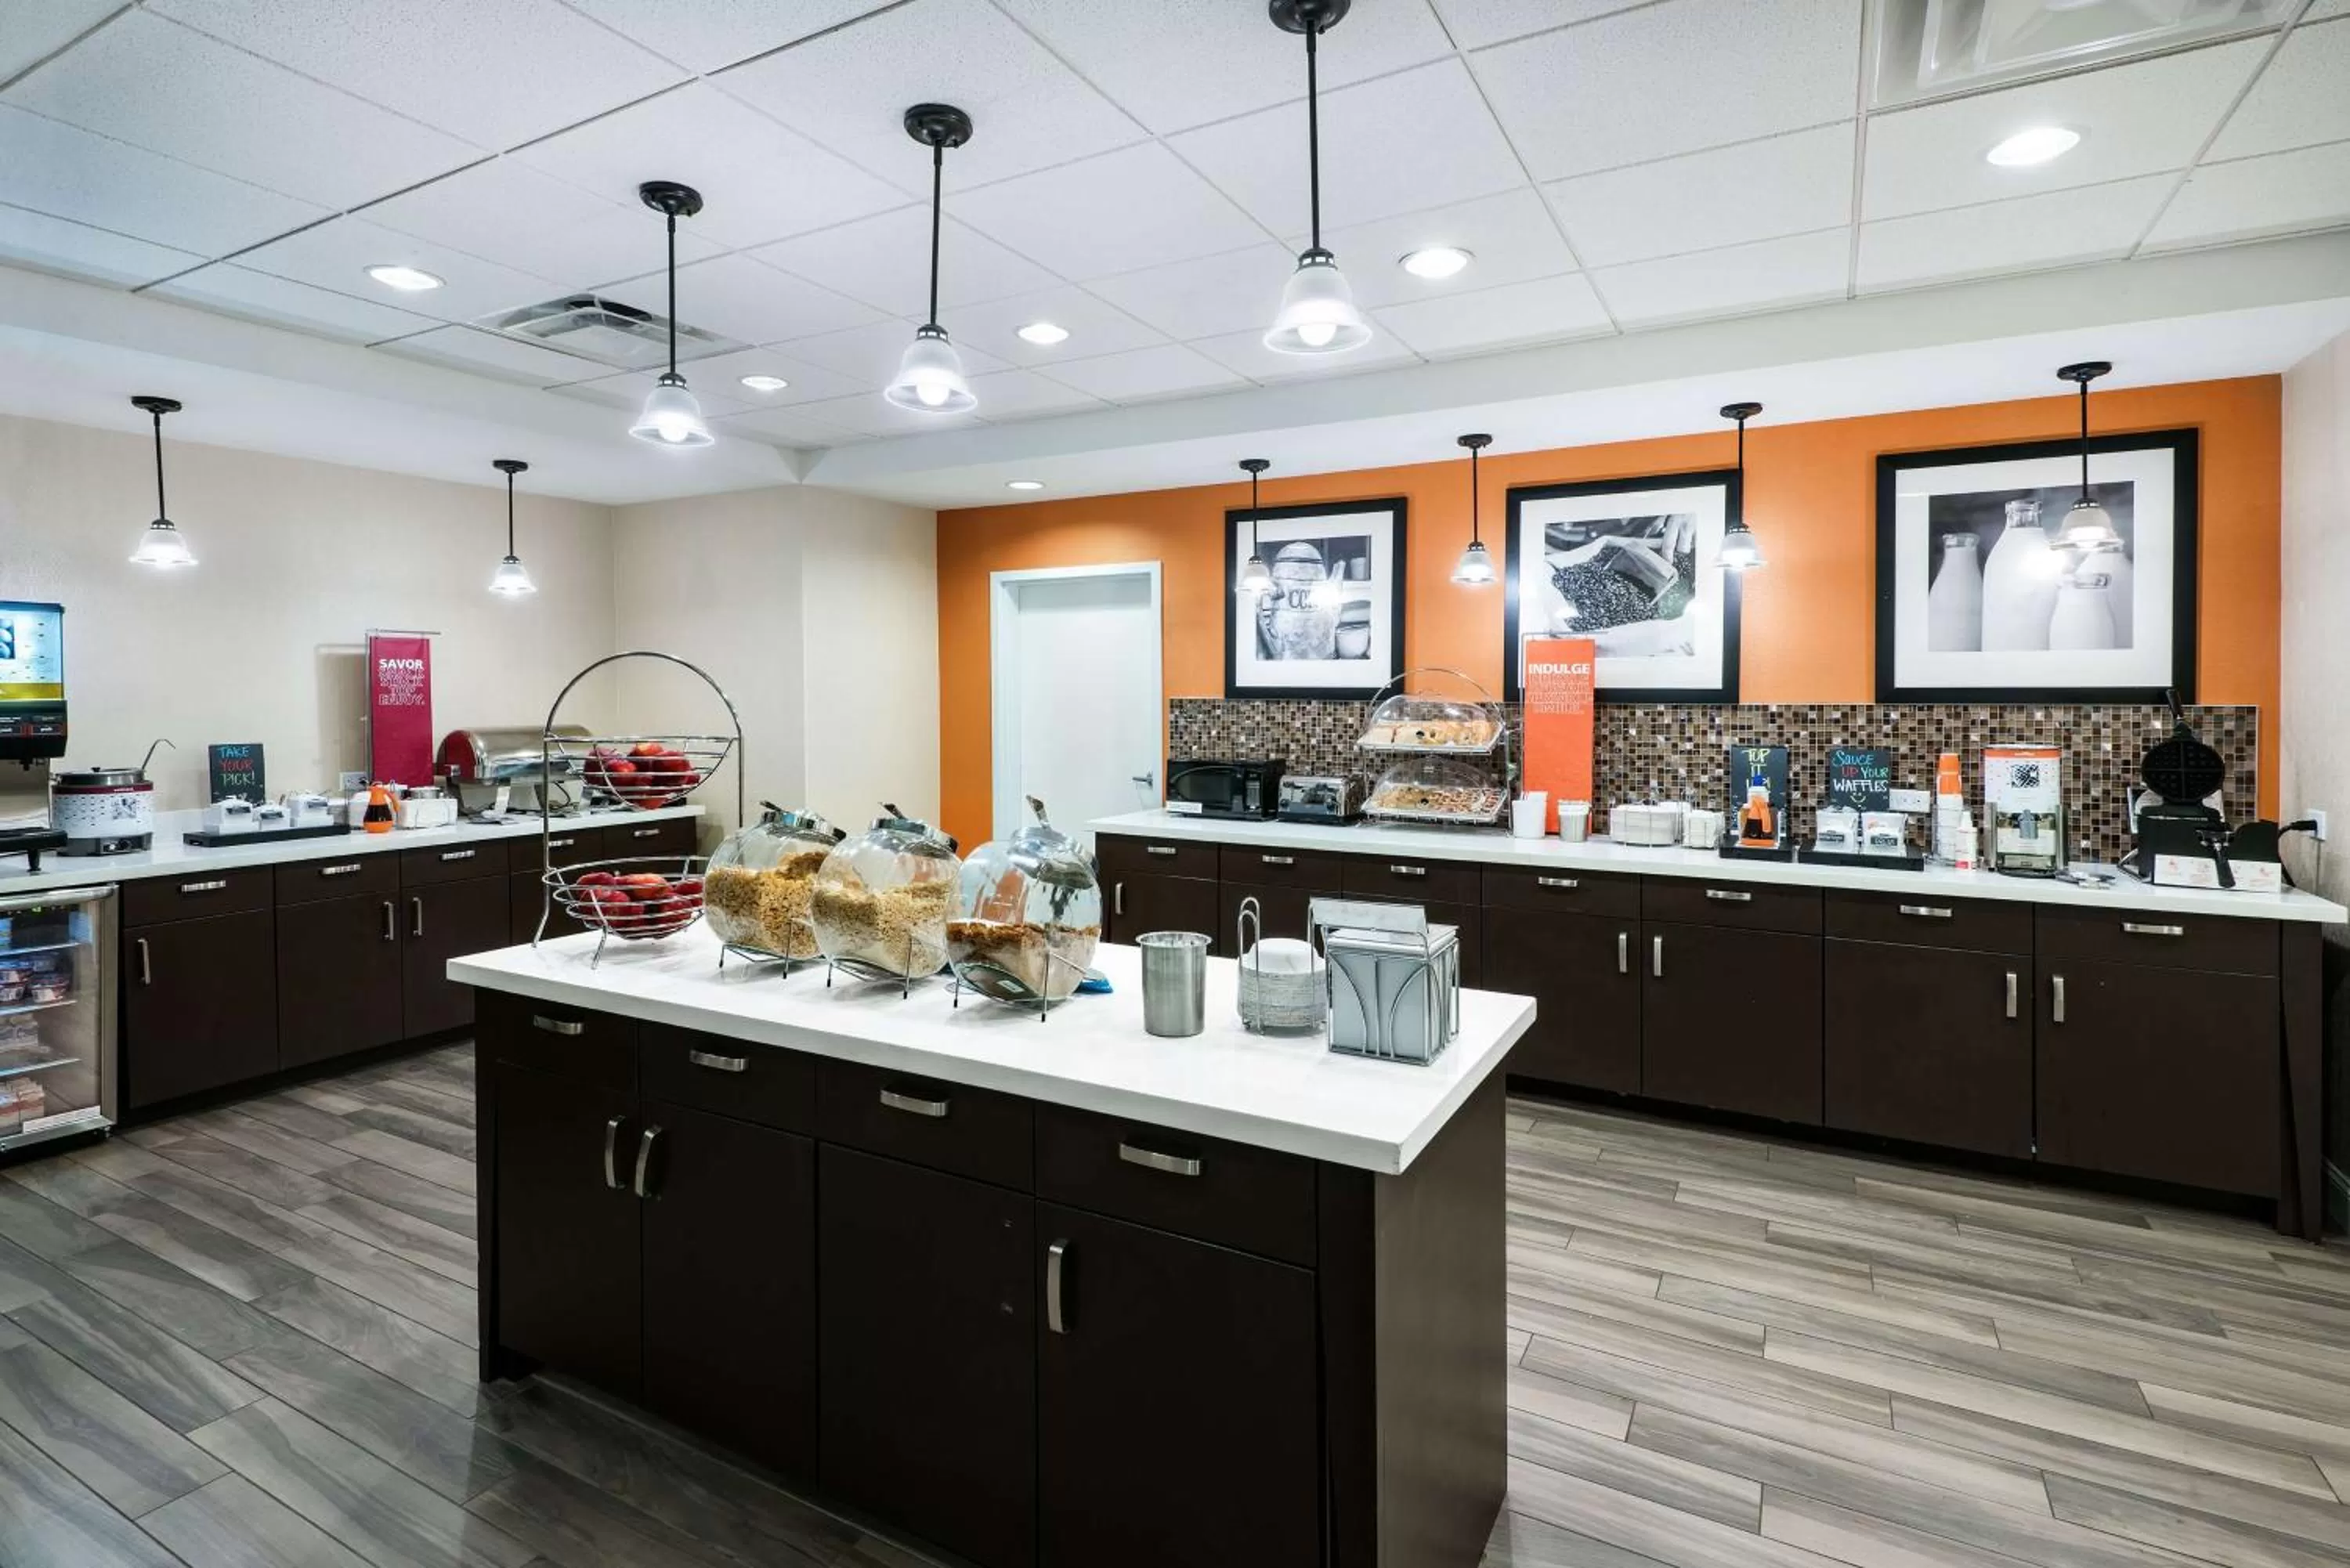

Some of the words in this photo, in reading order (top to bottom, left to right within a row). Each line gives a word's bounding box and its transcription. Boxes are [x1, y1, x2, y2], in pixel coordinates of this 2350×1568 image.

[378, 659, 424, 670] SAVOR
[1528, 663, 1591, 674] INDULGE
[217, 746, 251, 758] TAKE
[221, 759, 254, 771] YOUR
[220, 770, 255, 786] PICK!
[1842, 767, 1859, 778] UP
[1860, 766, 1889, 779] YOUR
[1833, 778, 1889, 793] WAFFLES
